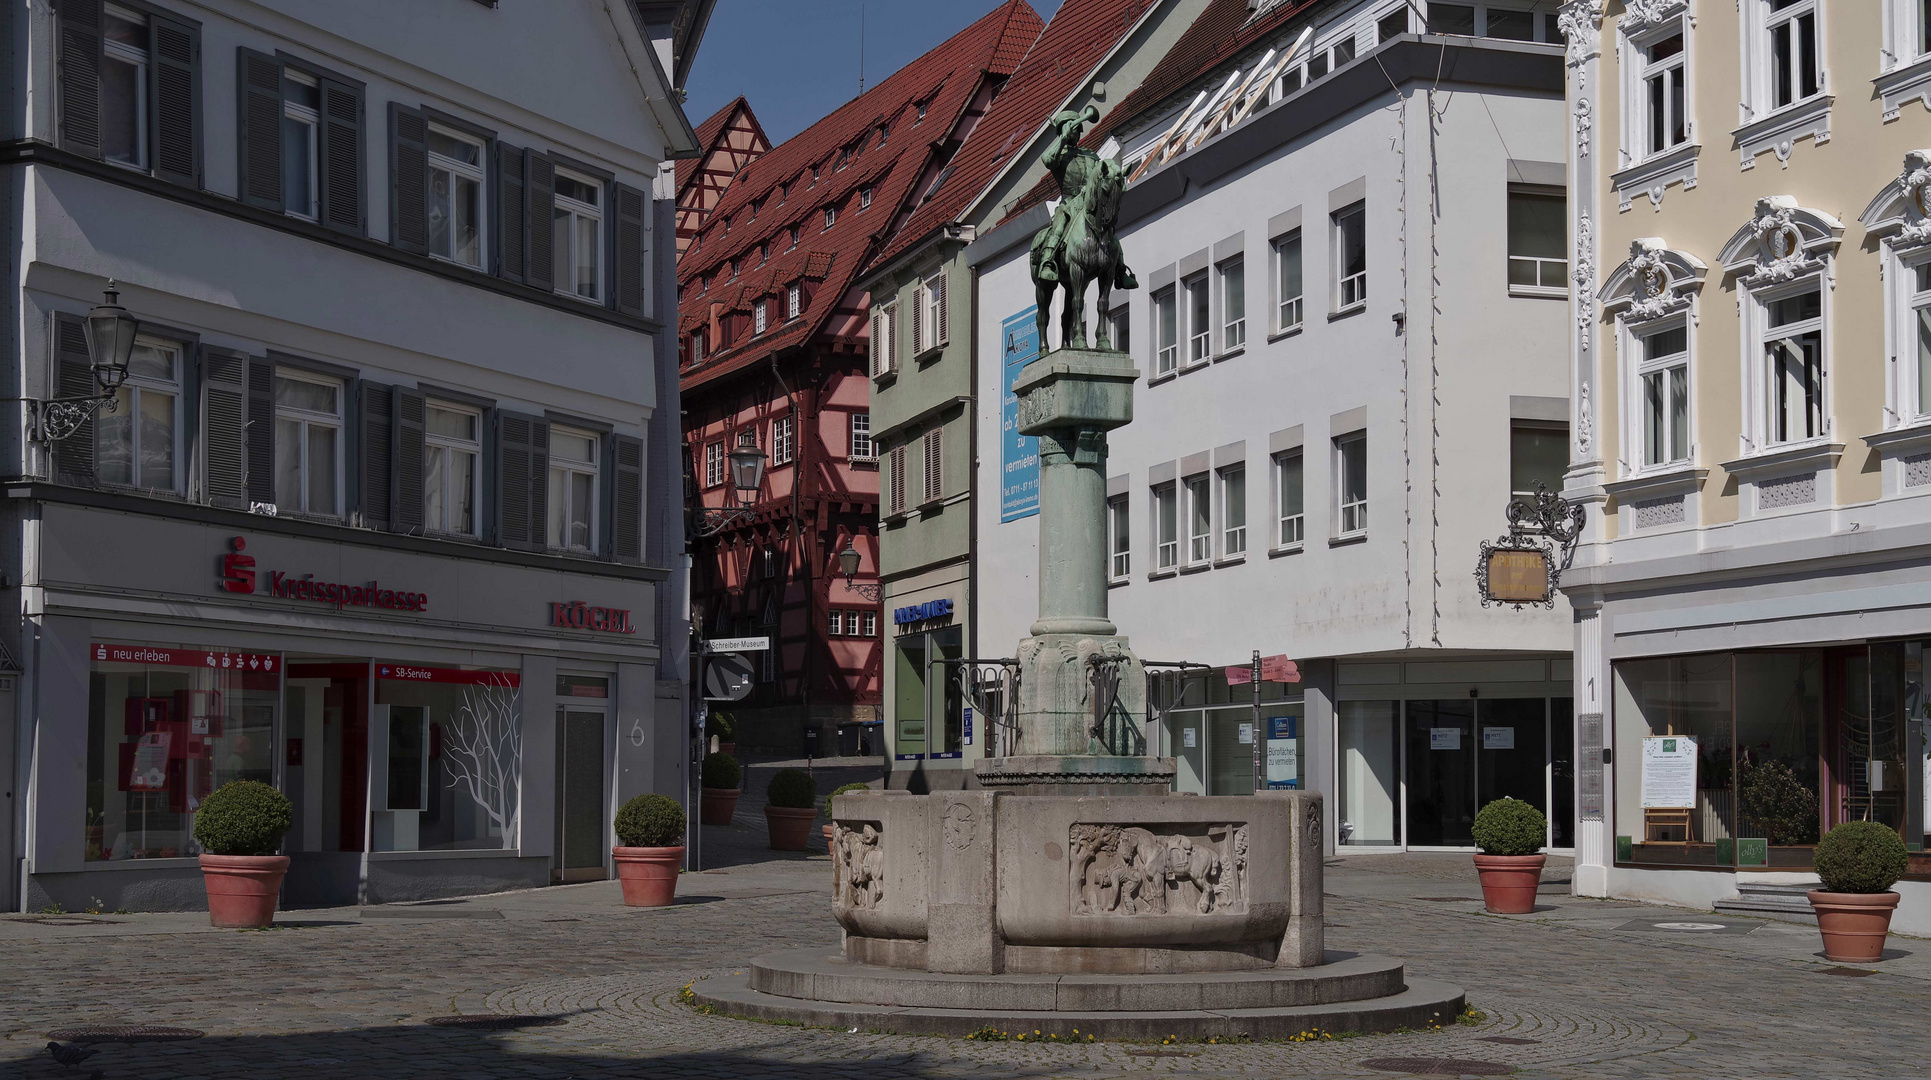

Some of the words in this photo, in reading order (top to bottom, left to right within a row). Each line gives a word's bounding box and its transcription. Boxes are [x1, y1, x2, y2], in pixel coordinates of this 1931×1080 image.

[1005, 415, 1013, 431] ab
[1017, 437, 1026, 448] zu
[1005, 454, 1038, 473] vermieten
[1011, 484, 1020, 495] 0711
[1491, 555, 1542, 568] APOTHEKE
[271, 570, 428, 612] Kreissparkasse
[712, 640, 765, 650] Schreiber-Museum
[113, 650, 132, 661] neu
[134, 649, 170, 663] erleben
[395, 667, 432, 680] SB-Service
[1587, 677, 1595, 701] 1
[630, 718, 645, 747] 6
[1268, 747, 1295, 756] Büroflächen
[1275, 757, 1295, 766] vermieten
[1741, 844, 1763, 858] olly's
